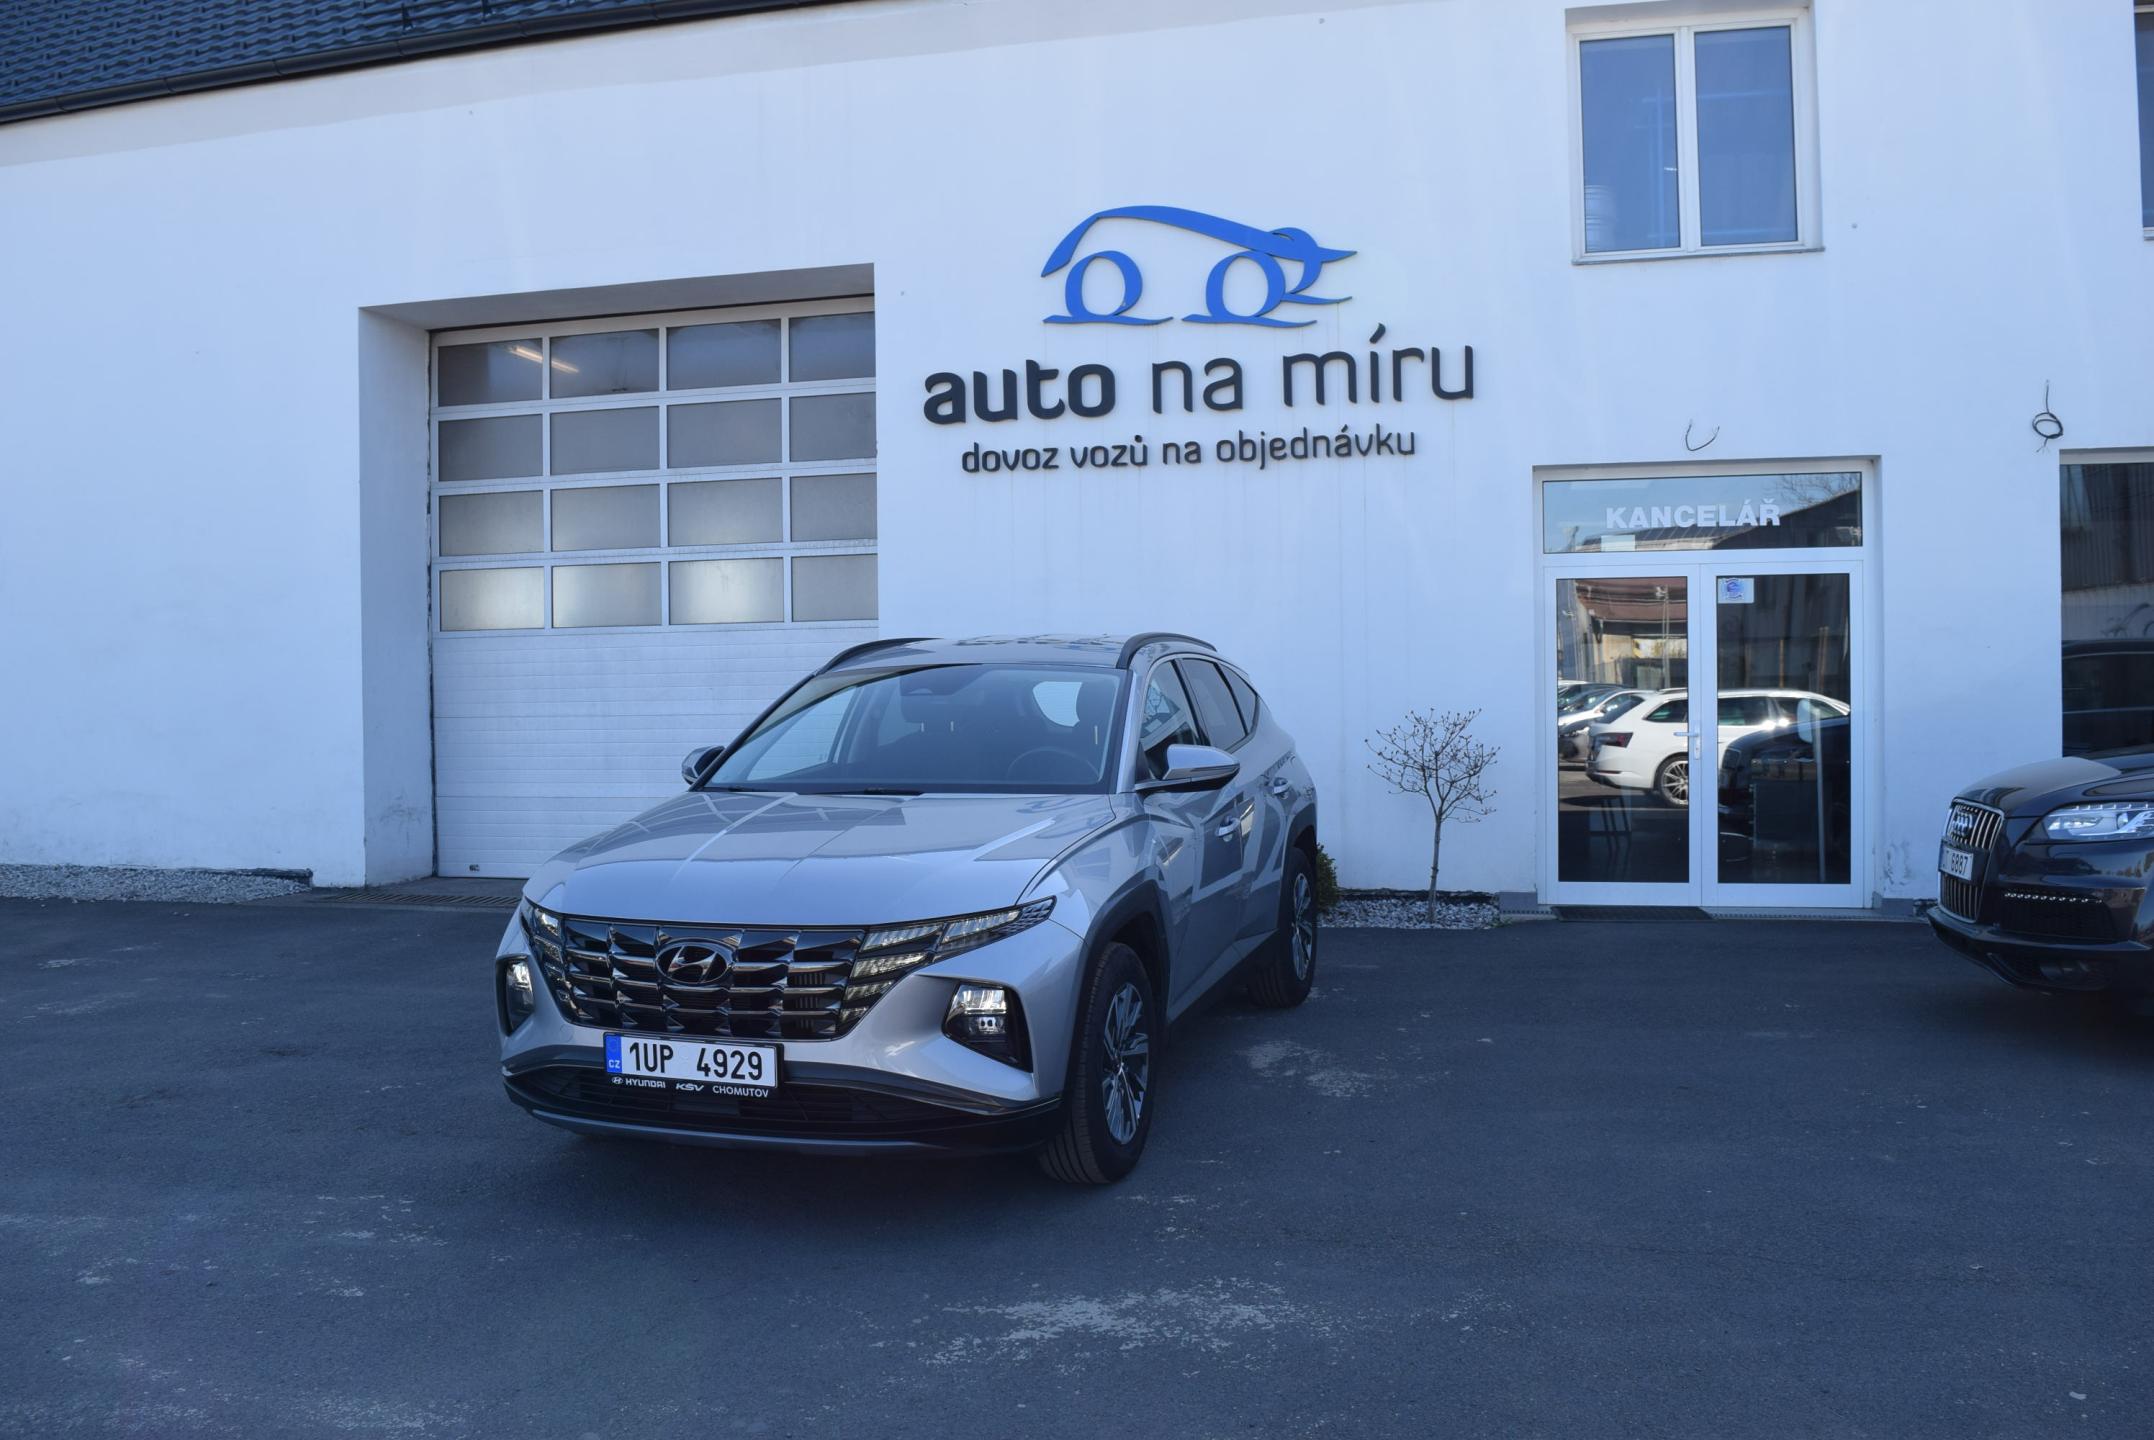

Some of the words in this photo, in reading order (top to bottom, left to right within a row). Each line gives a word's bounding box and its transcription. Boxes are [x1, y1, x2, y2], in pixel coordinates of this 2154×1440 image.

[923, 359, 1116, 426] auto
[1152, 357, 1243, 415] na
[1282, 323, 1474, 408] míru
[961, 442, 1060, 474] dovoz
[1070, 434, 1148, 469] vozů
[1162, 438, 1201, 465] na
[1216, 423, 1416, 470] objednávku
[1605, 498, 1781, 529] KANCELÁŘ
[608, 1059, 621, 1069] CZ
[629, 1042, 674, 1074] 1UP
[696, 1047, 763, 1081] 4929
[625, 1078, 666, 1089] HYUNDAI
[675, 1082, 705, 1092] KSV
[712, 1085, 769, 1098] CHOMUTOV
